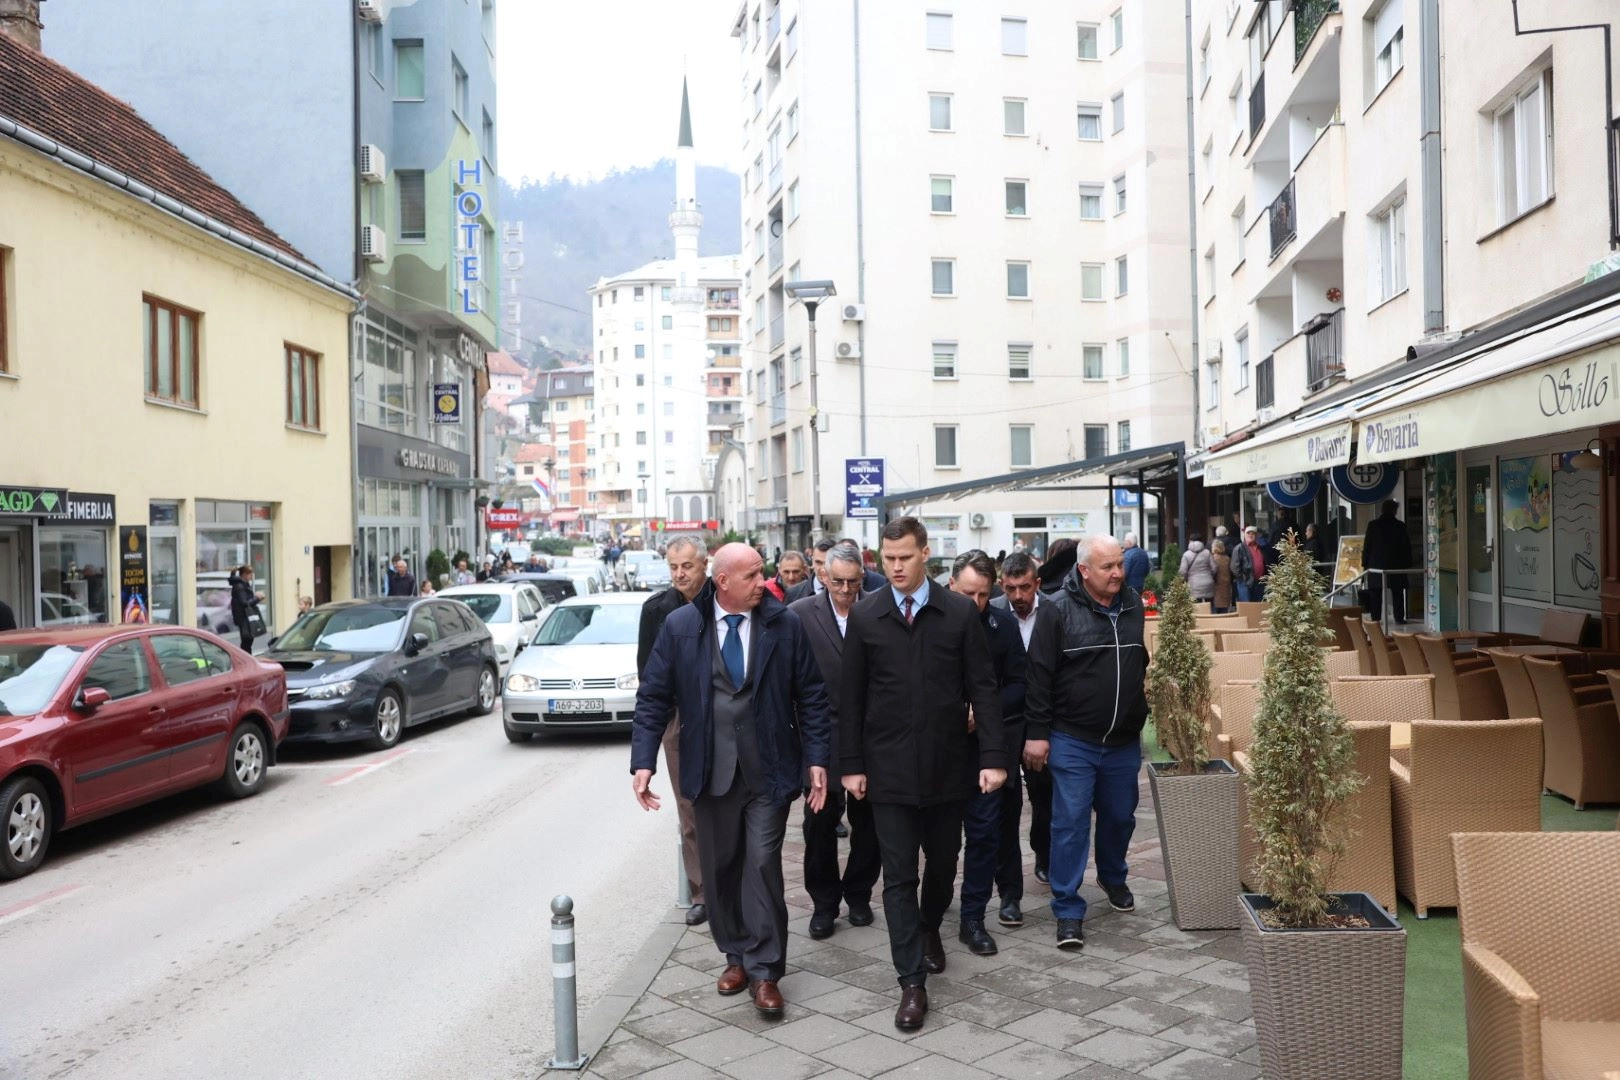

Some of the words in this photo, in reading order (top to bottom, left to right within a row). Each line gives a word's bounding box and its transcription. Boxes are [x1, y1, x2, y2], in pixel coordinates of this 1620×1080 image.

[458, 159, 482, 313] HOTEL
[1539, 362, 1608, 417] Sollo
[1376, 421, 1419, 454] Bavaria
